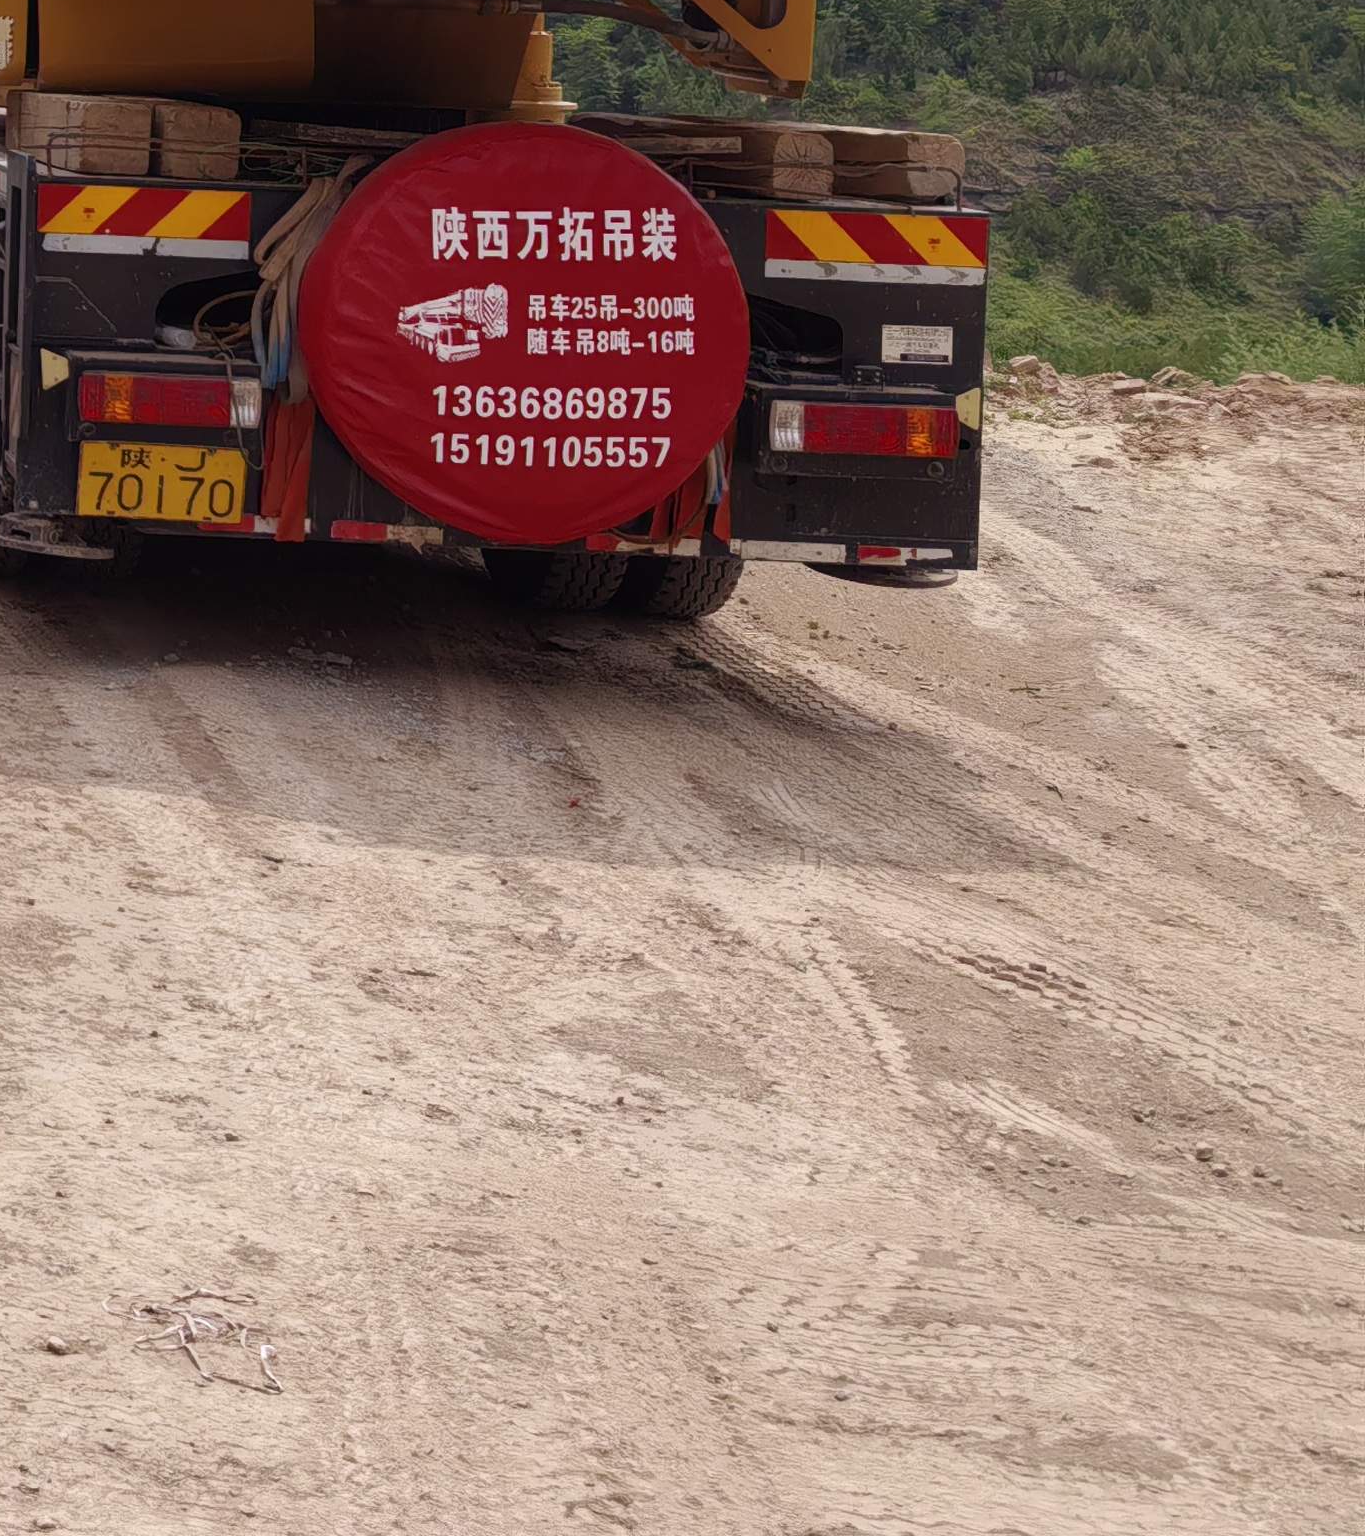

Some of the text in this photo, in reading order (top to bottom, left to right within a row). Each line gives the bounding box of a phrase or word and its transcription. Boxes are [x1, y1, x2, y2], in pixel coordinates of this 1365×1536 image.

[430, 206, 678, 263] 陕西万拓吊装
[431, 384, 673, 420] 13636869875
[429, 432, 672, 469] 15191105557
[87, 470, 237, 519] 70170
